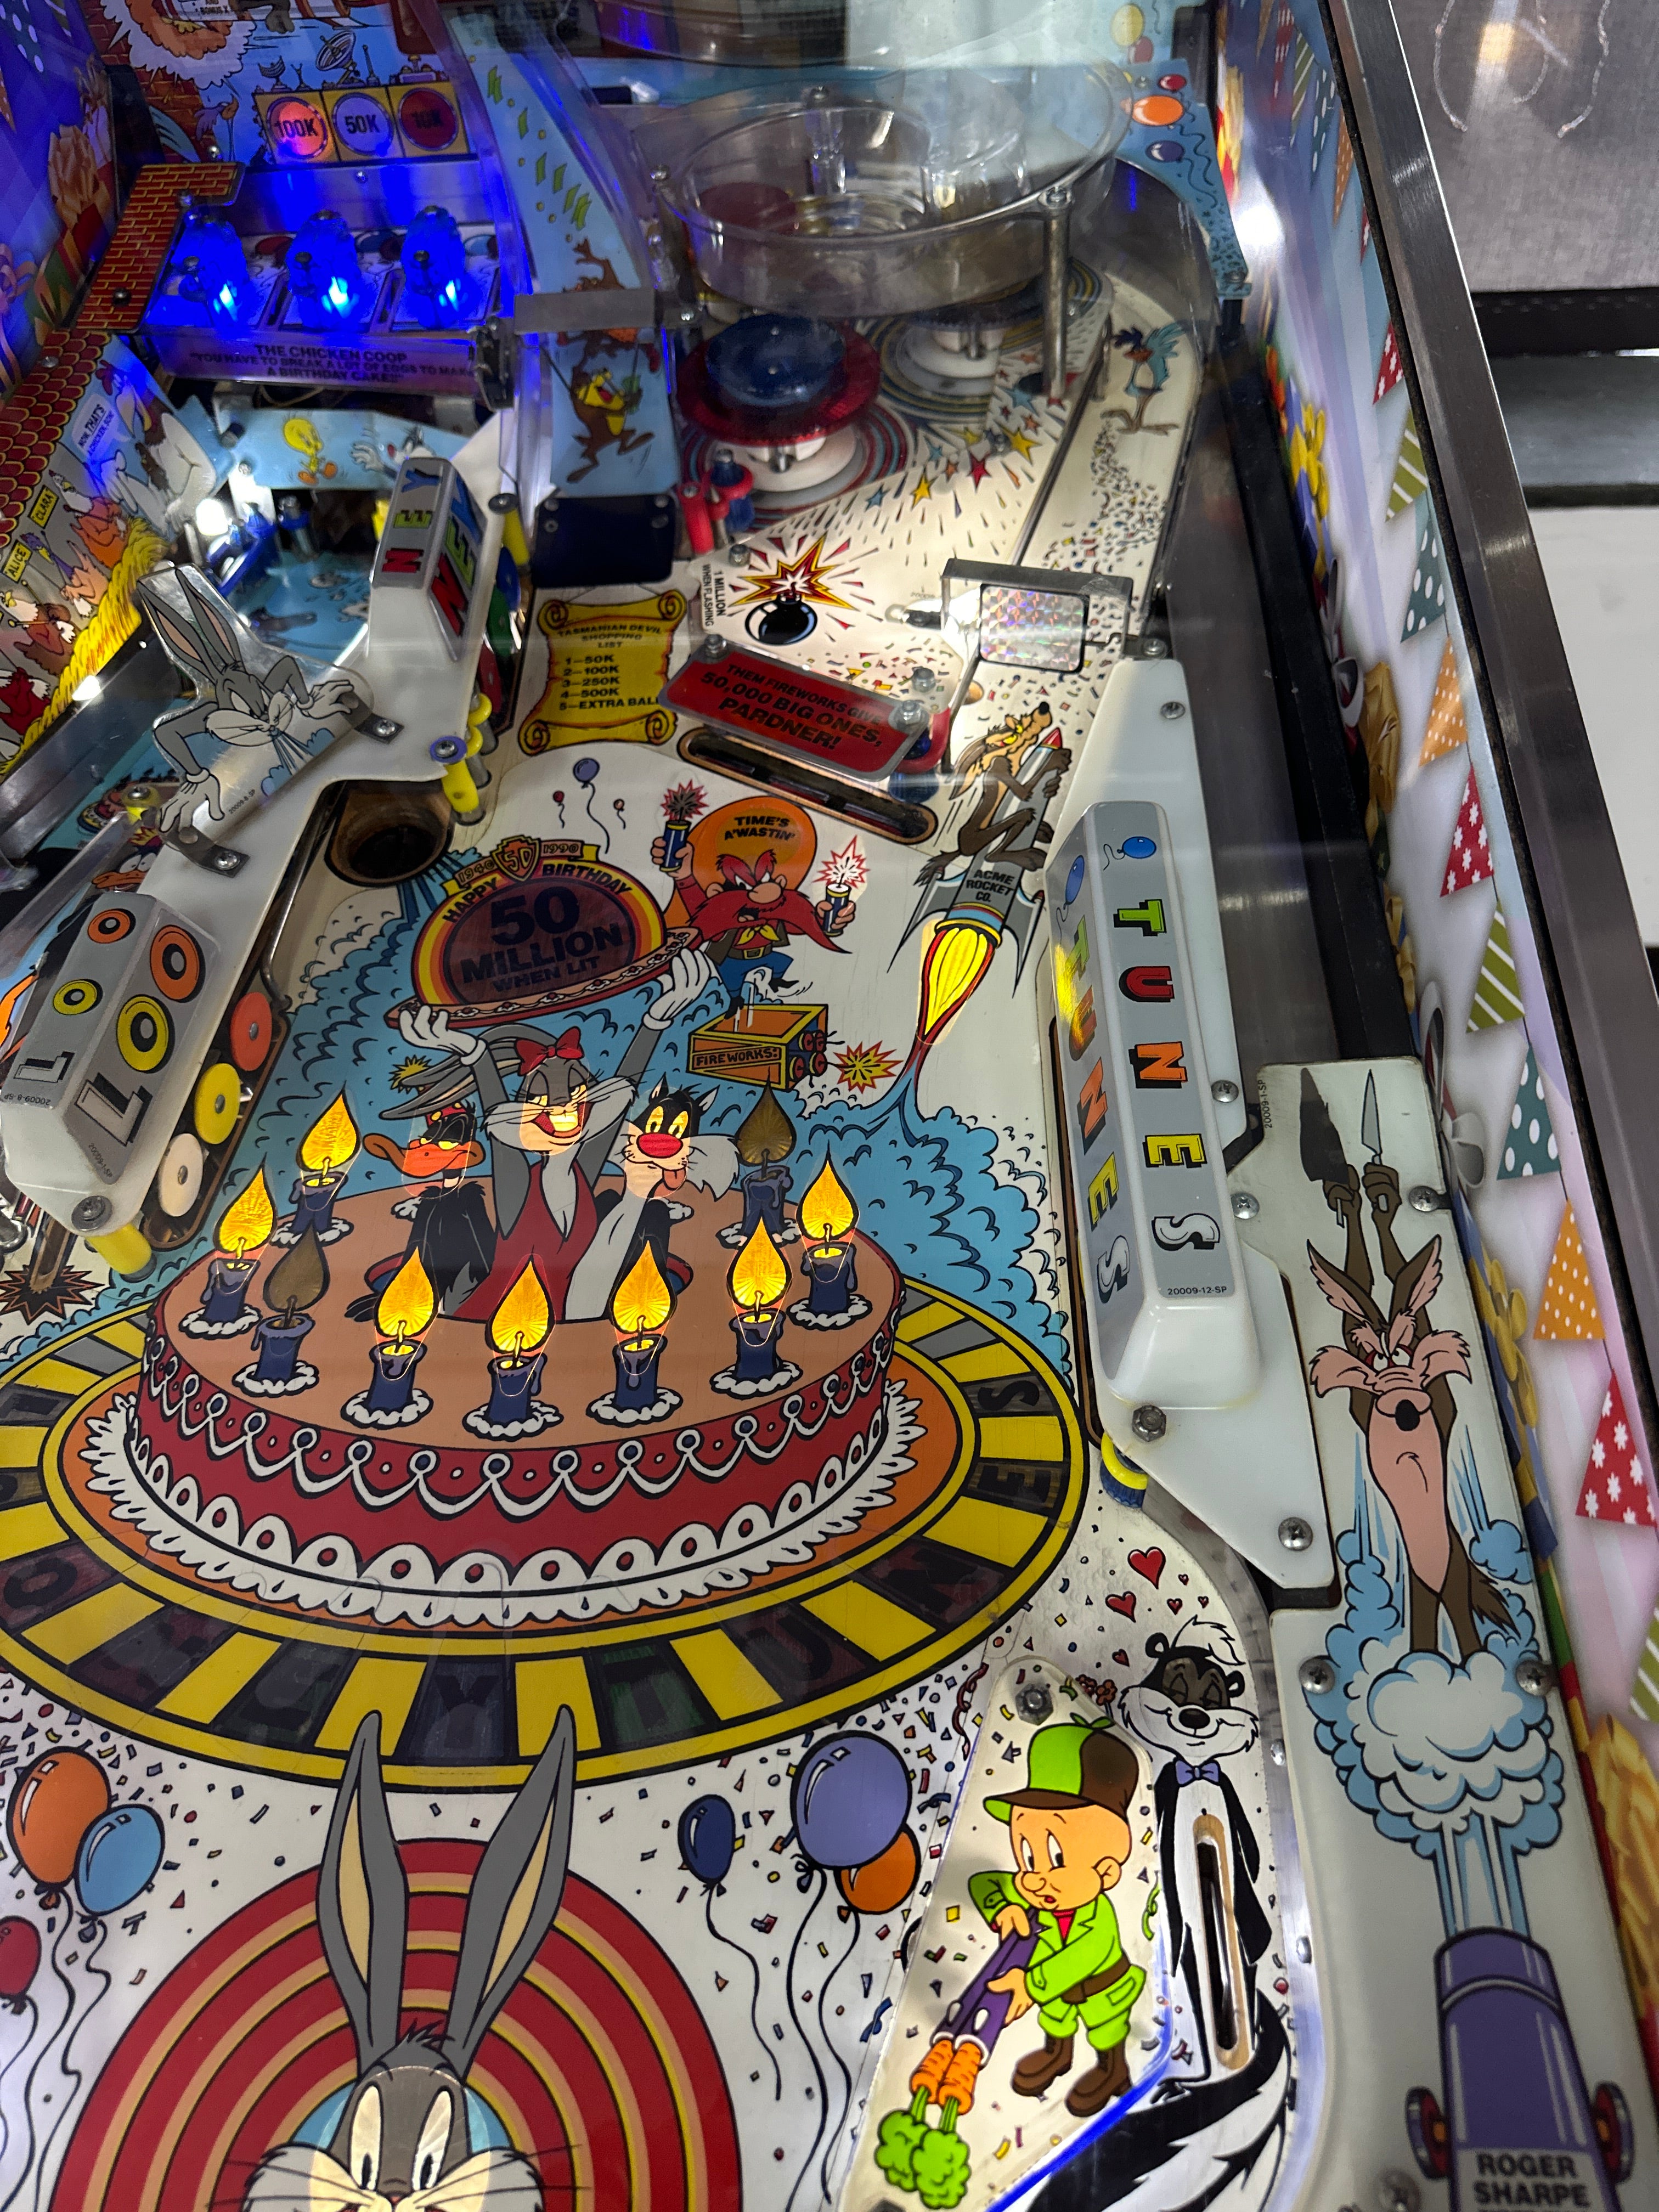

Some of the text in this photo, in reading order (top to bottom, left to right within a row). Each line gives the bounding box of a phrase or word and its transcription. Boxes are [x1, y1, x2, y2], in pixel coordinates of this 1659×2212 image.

[275, 118, 318, 138] 100K
[344, 114, 381, 134] 50K
[255, 345, 408, 363] THE CHICKEN COOP
[225, 355, 258, 365] HAVE
[263, 357, 277, 366] TO
[280, 357, 321, 367] BREAK
[328, 359, 334, 368] A
[336, 360, 360, 370] LOT
[382, 363, 417, 374] EGGS
[419, 364, 436, 375] TO
[268, 367, 276, 376] A
[279, 367, 348, 380] BIRTHDAY
[36, 494, 54, 521] CLARA
[8, 548, 26, 577] ALICE
[702, 564, 714, 627] WHEN FLASHING
[714, 578, 727, 617] MILLION
[557, 624, 662, 637] TASMANIAN DEVIL
[582, 633, 643, 641] SHOPPING
[726, 664, 884, 726] THEM FIREWORKS GIVE
[701, 671, 884, 748] 50,000 BIG ONES,
[718, 697, 842, 751] PARDNER!
[734, 816, 790, 828] TIME'S
[724, 827, 795, 841] A'WASTIN'
[543, 842, 579, 854] 1990
[974, 869, 1015, 885] ACME
[442, 864, 633, 923] HAPPY BIRTHDAY
[966, 879, 1015, 896] ROCKET
[975, 891, 991, 902] CO.
[490, 885, 580, 946] 50
[460, 923, 624, 985] MILLION
[493, 956, 600, 992] WHEN LIT
[696, 1047, 777, 1066] FIREWORKS:
[1257, 1079, 1273, 1129] 20009-1-SP
[1167, 1285, 1228, 1295] 20009-12-SP
[1477, 2152, 1578, 2178] ROGER
[1472, 2180, 1591, 2209] SHARPE
